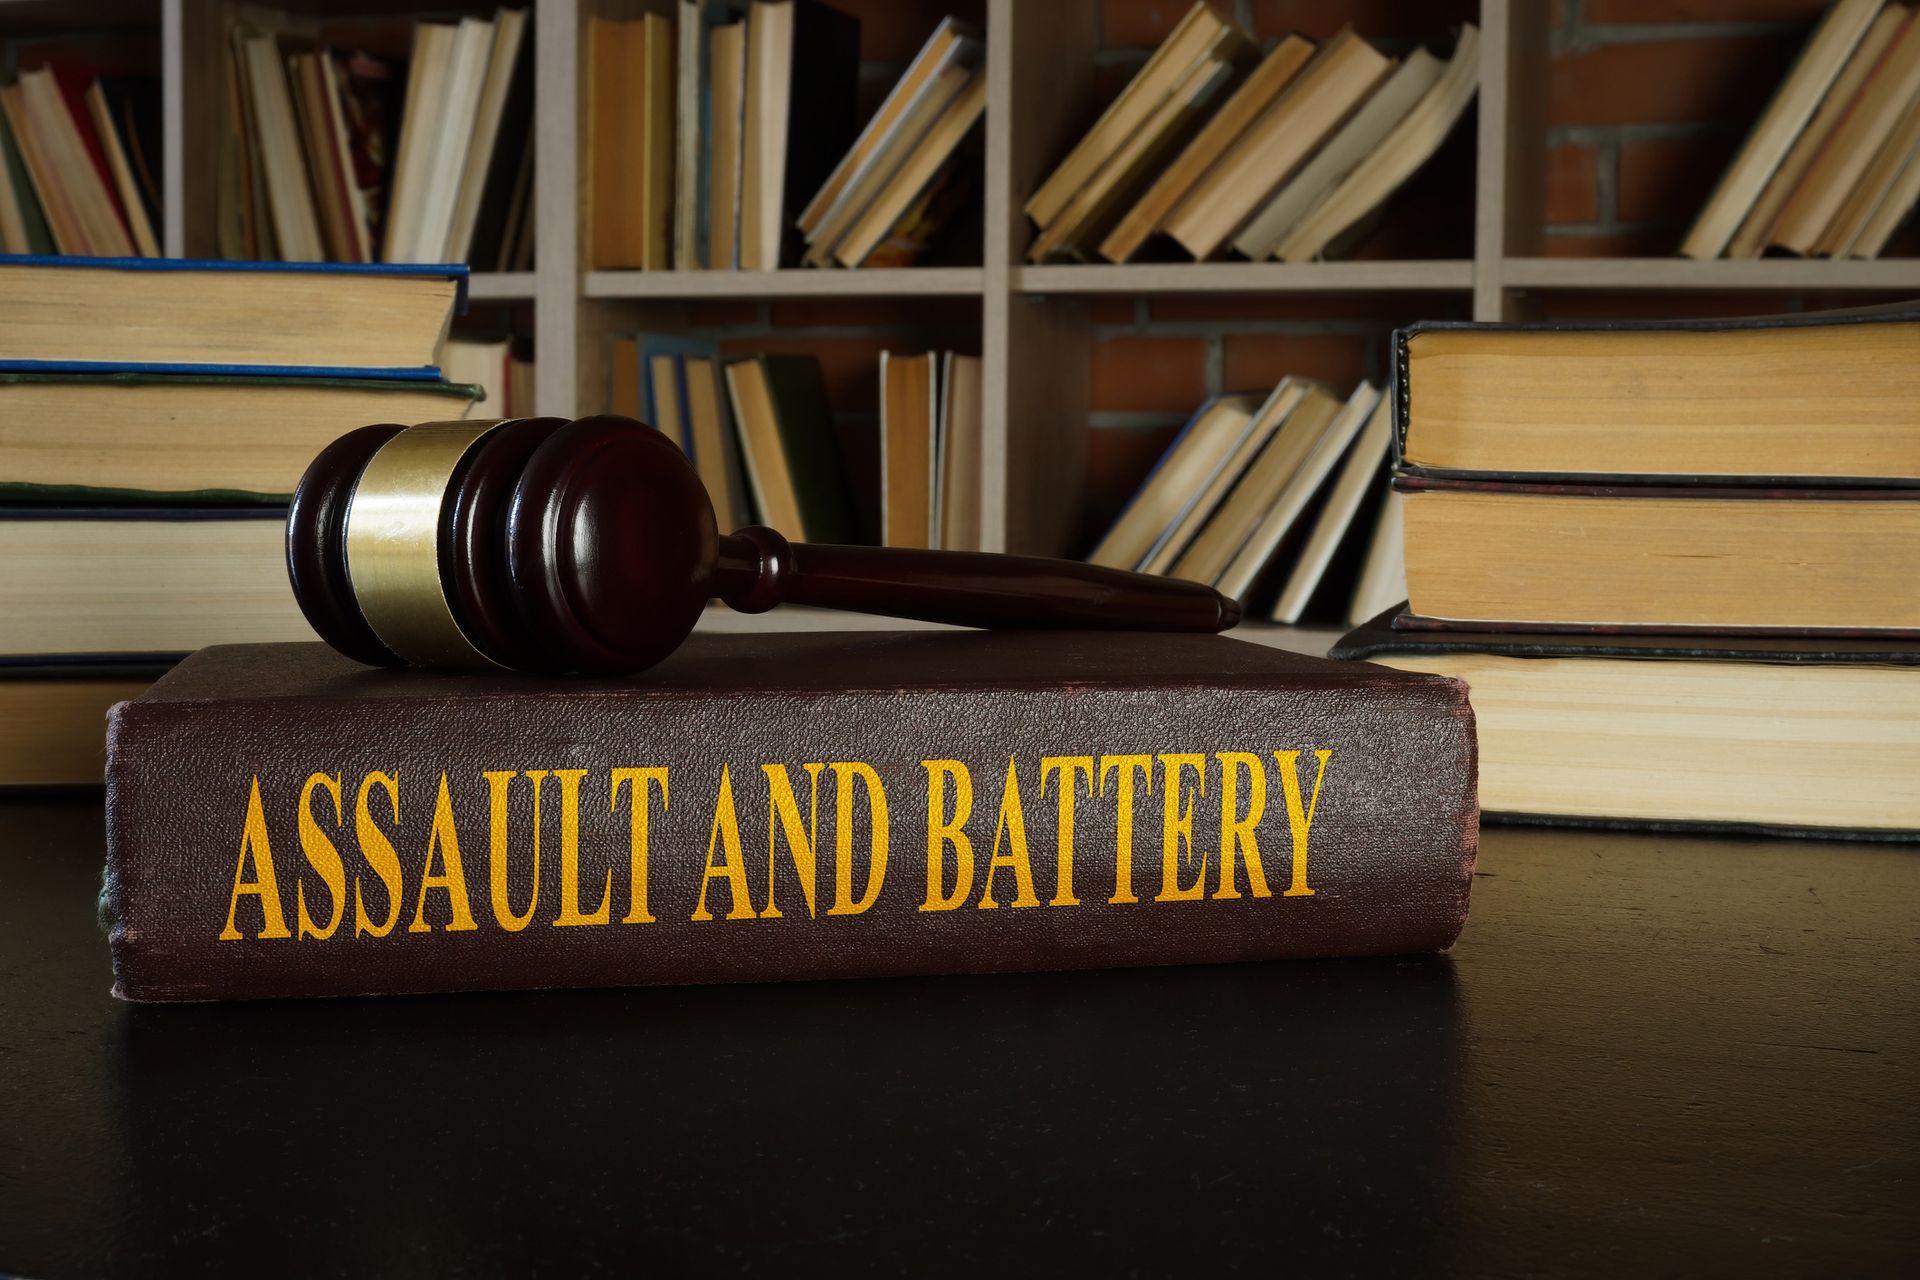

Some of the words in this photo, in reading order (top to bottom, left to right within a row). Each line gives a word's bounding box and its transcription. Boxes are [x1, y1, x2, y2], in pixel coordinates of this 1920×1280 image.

[218, 767, 670, 942] ASSAULT
[690, 762, 890, 922] AND
[918, 748, 1333, 913] BATTERY
